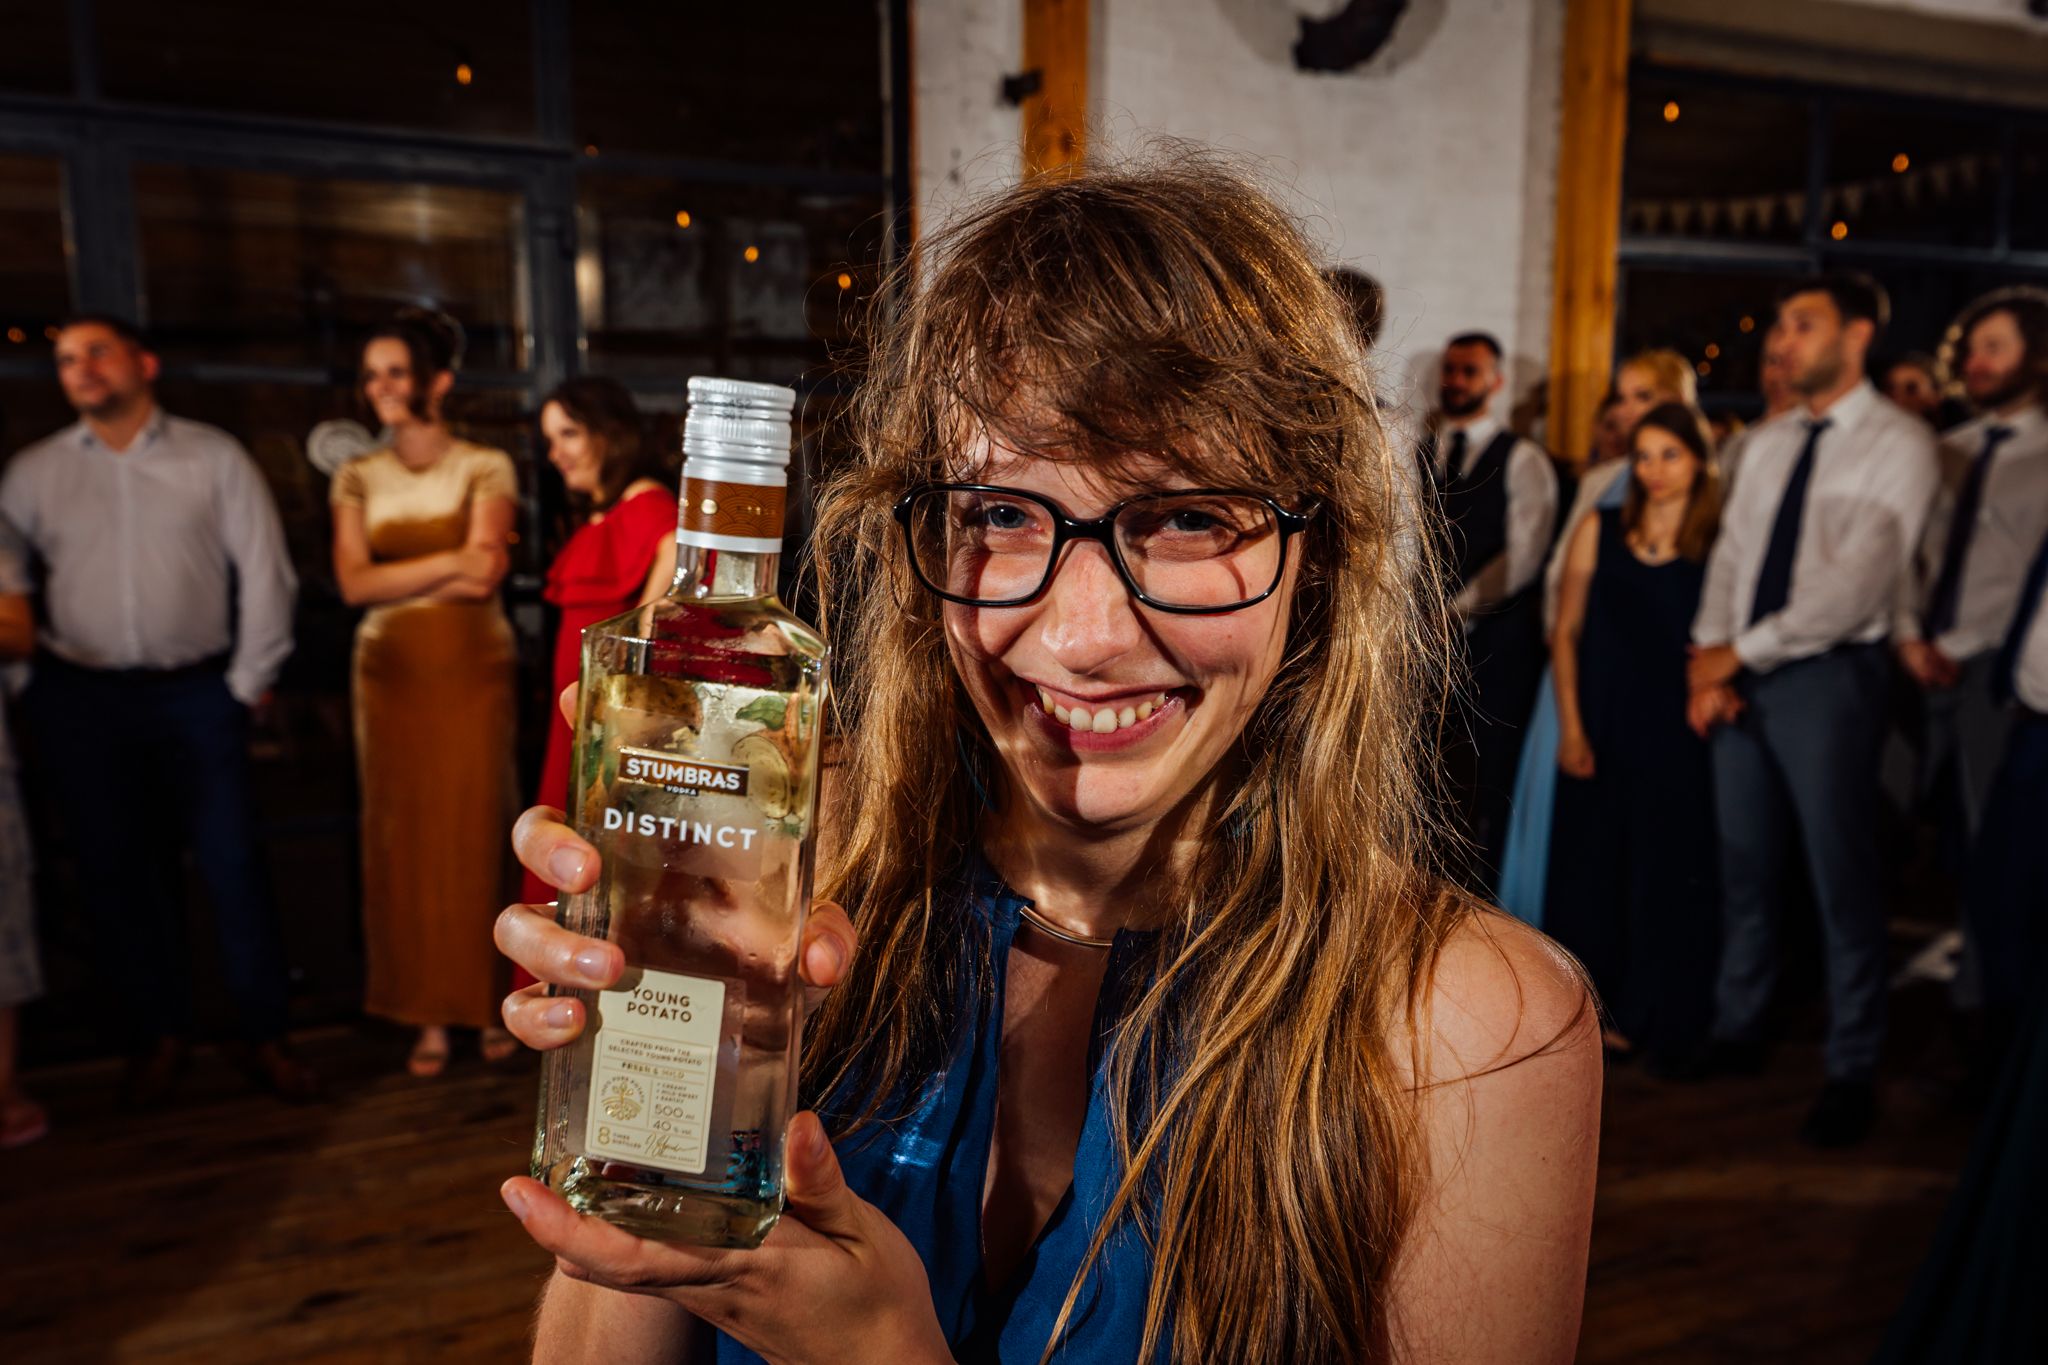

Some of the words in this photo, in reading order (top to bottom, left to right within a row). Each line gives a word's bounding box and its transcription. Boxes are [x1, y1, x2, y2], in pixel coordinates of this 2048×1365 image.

[626, 757, 741, 790] STUMBRAS
[665, 785, 697, 796] VODKA
[603, 807, 757, 850] DISTINCT
[631, 988, 691, 1007] YOUNG
[627, 1001, 692, 1023] POTATO
[608, 1044, 642, 1056] SELECTED
[645, 1052, 671, 1061] YOUNG
[673, 1056, 703, 1066] POTATO
[620, 1038, 653, 1049] CRAFTED
[654, 1044, 675, 1053] FROM
[677, 1049, 690, 1057] THE
[622, 1061, 651, 1073] FRESH
[655, 1103, 684, 1119] 500
[653, 1119, 672, 1132] 40
[598, 1126, 610, 1145] 8
